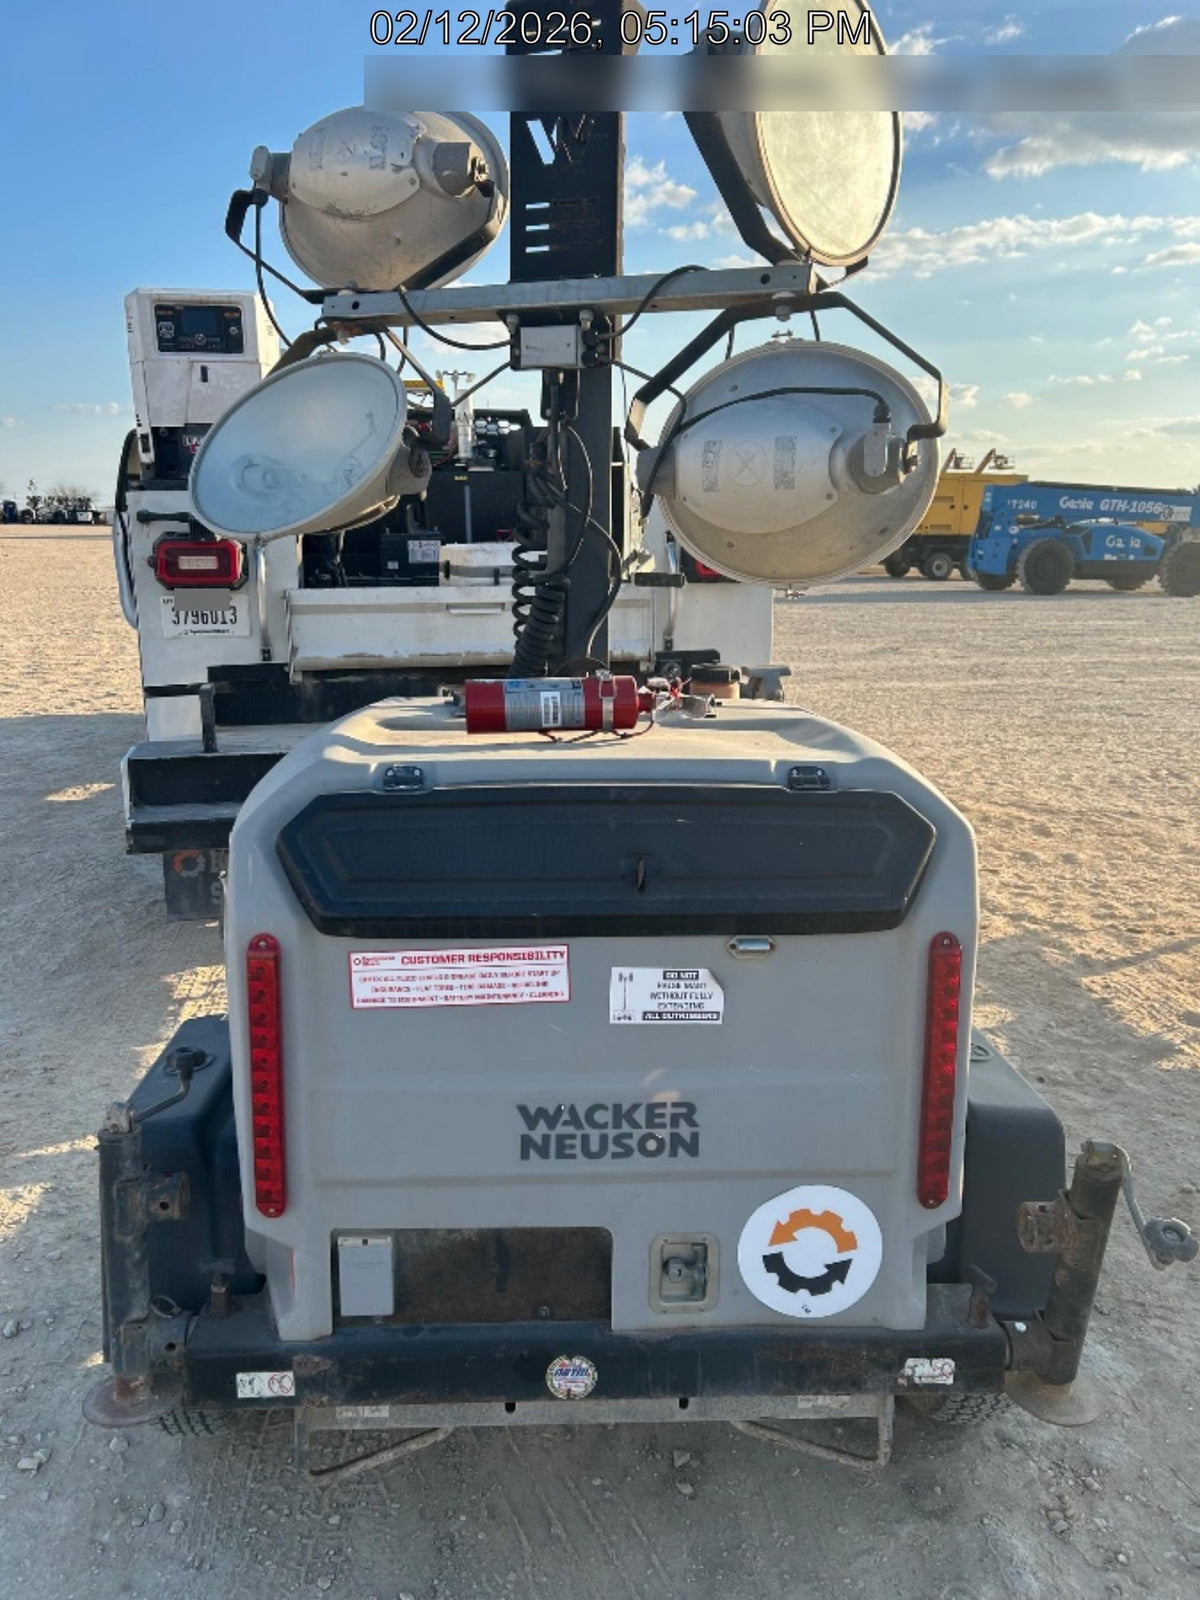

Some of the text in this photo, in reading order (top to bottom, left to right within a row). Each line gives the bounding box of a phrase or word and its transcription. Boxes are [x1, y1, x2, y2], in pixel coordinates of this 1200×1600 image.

[1100, 499, 1162, 514] GTH-1056
[401, 954, 465, 966] CUSTOMER
[468, 950, 566, 963] RESPONSIBILITY
[516, 1101, 700, 1131] WACKER
[519, 1131, 700, 1160] NEUSON
